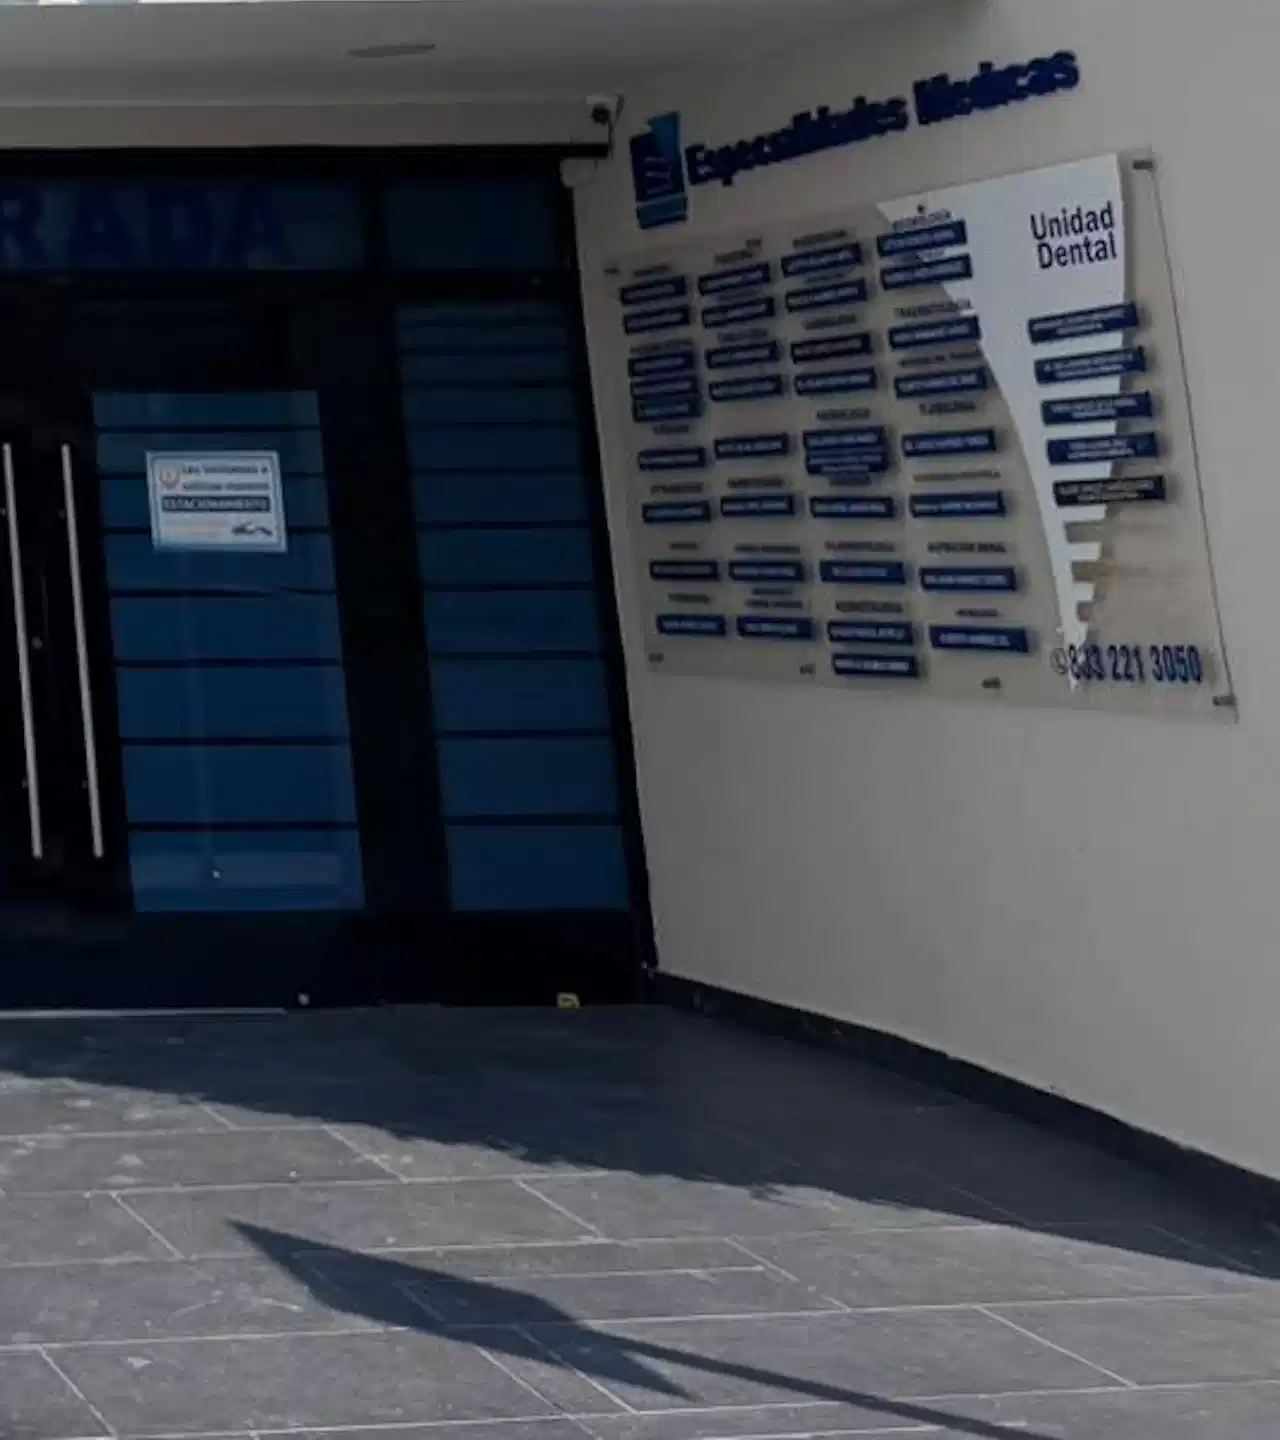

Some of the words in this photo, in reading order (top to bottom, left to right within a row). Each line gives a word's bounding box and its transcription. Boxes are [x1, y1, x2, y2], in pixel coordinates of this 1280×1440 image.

[1030, 200, 1115, 241] Unidad
[1036, 232, 1118, 269] Dental
[1107, 643, 1145, 681] 221
[1149, 643, 1204, 683] 3050
